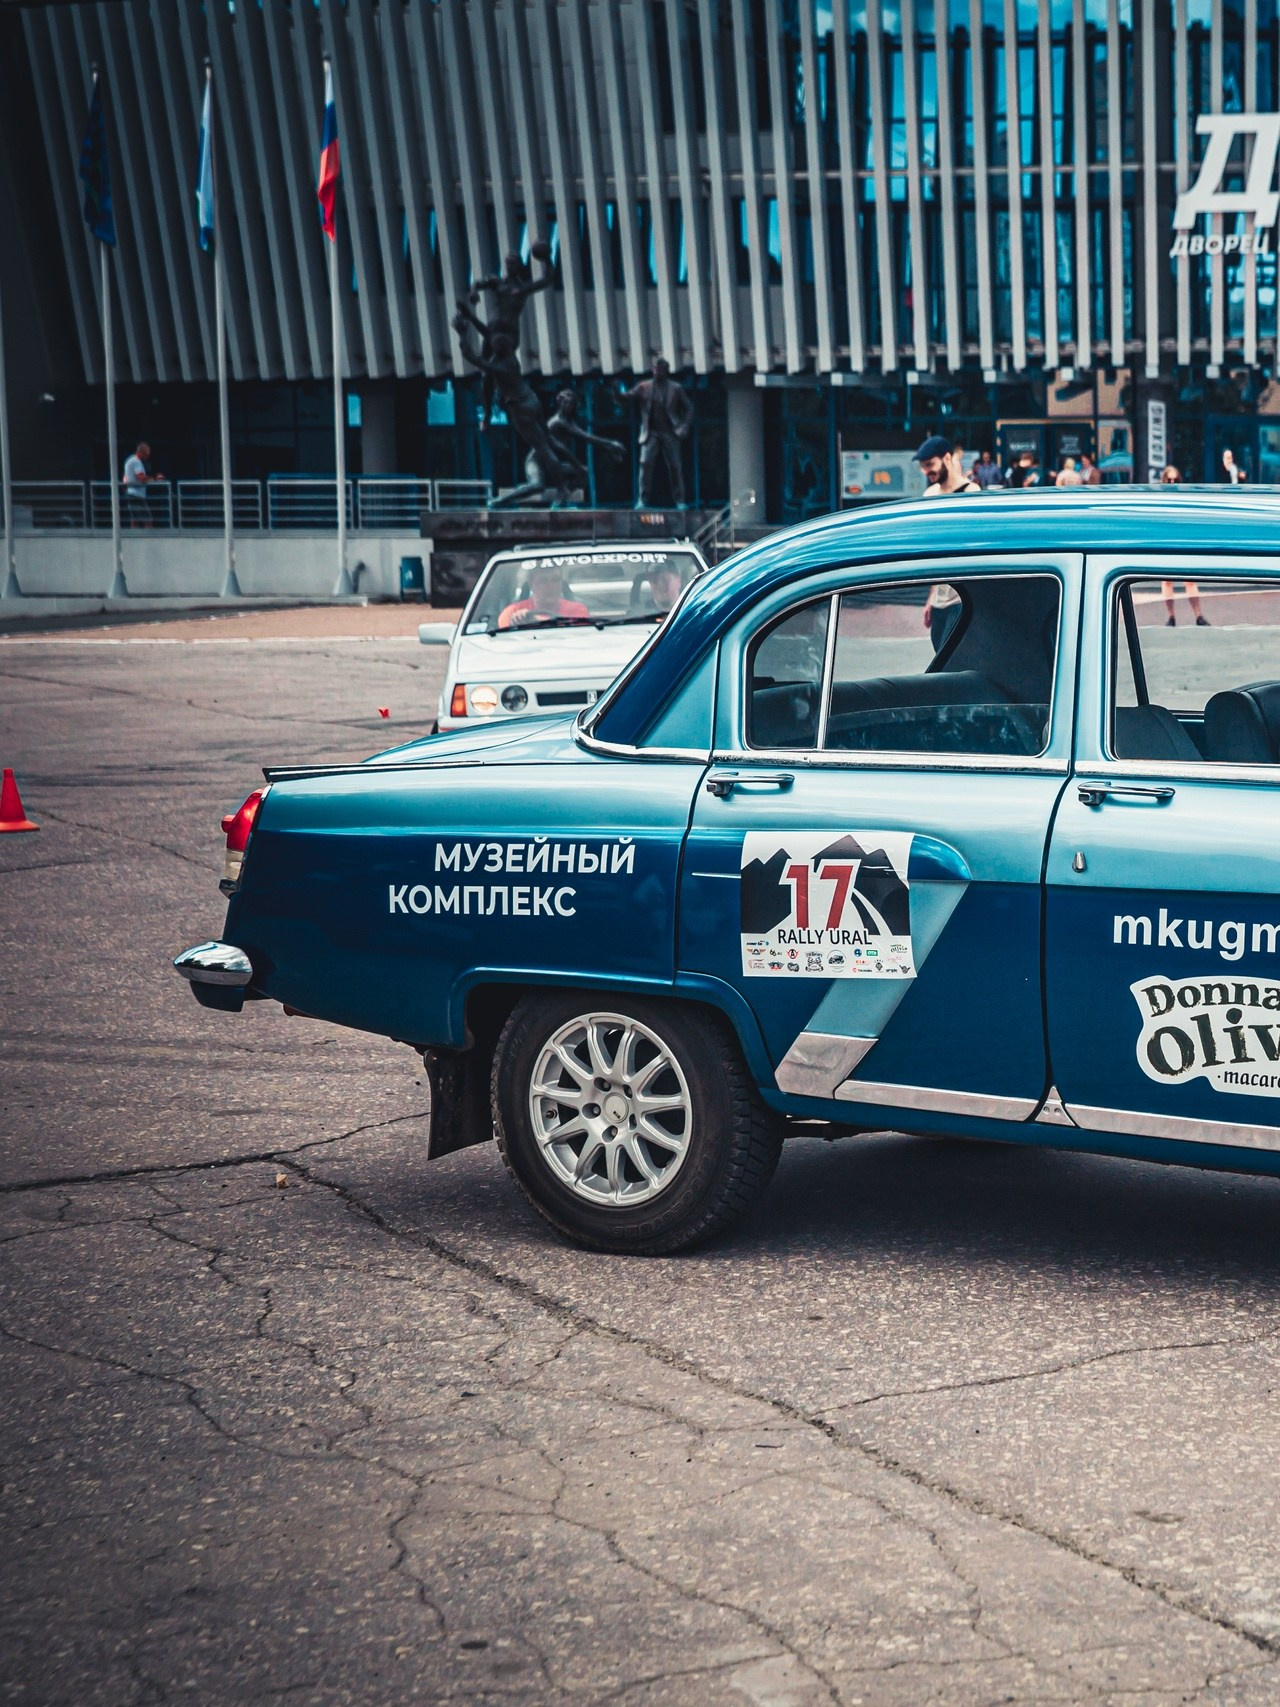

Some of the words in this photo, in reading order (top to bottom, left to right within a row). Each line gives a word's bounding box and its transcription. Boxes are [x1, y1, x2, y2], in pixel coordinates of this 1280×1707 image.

[1169, 231, 1269, 259] ДВОРЕЦ
[540, 553, 667, 568] AVTOEXPORT
[434, 836, 636, 875] МУЗЕЙНЫЙ
[388, 884, 577, 917] КОМПЛЕКС
[786, 864, 854, 931] 17
[778, 929, 824, 945] RALLY
[829, 930, 873, 946] URAL
